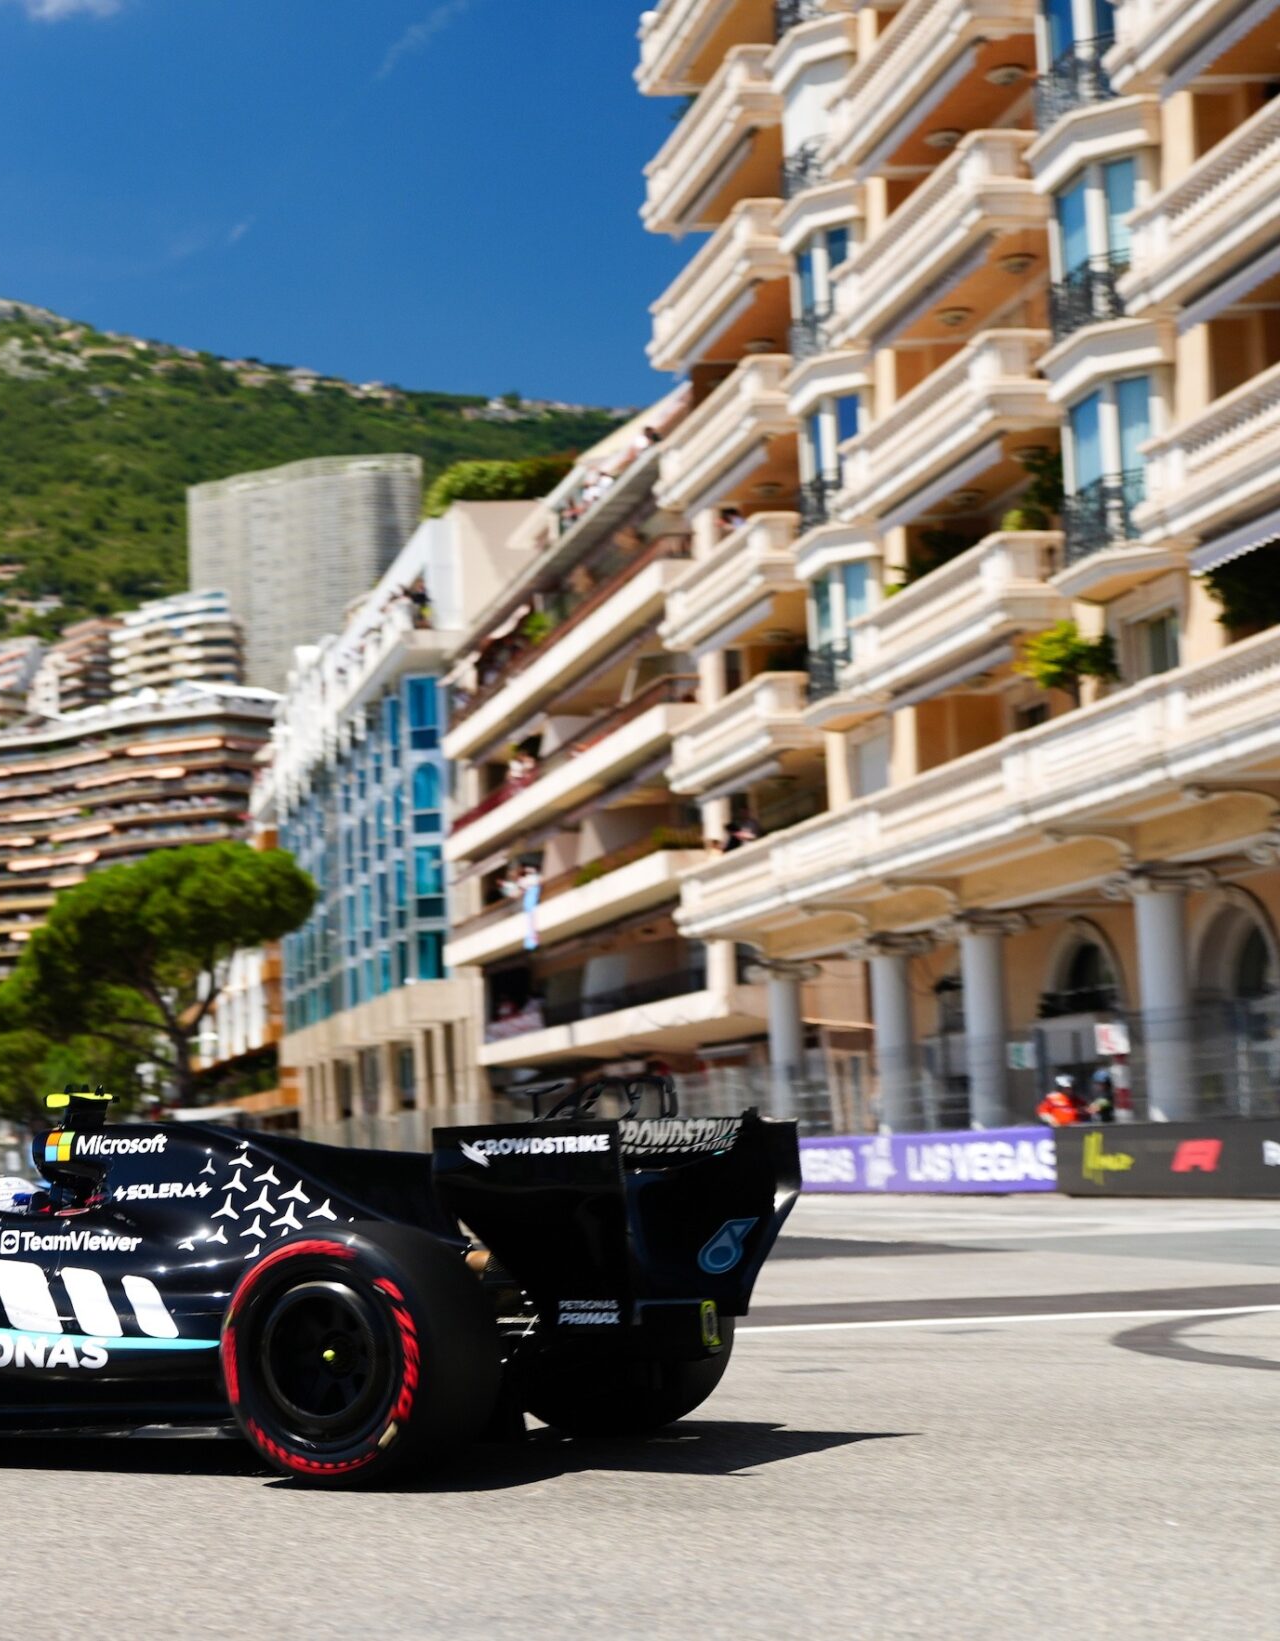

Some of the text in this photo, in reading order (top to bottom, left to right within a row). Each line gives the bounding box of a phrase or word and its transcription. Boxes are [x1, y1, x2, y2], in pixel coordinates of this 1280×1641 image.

[76, 1133, 168, 1155] Microsoft
[472, 1134, 610, 1156] CROWDSTRIKE
[126, 1183, 197, 1200] SOLERA
[20, 1230, 142, 1252] TeamViewer
[558, 1311, 620, 1325] PRIMAX
